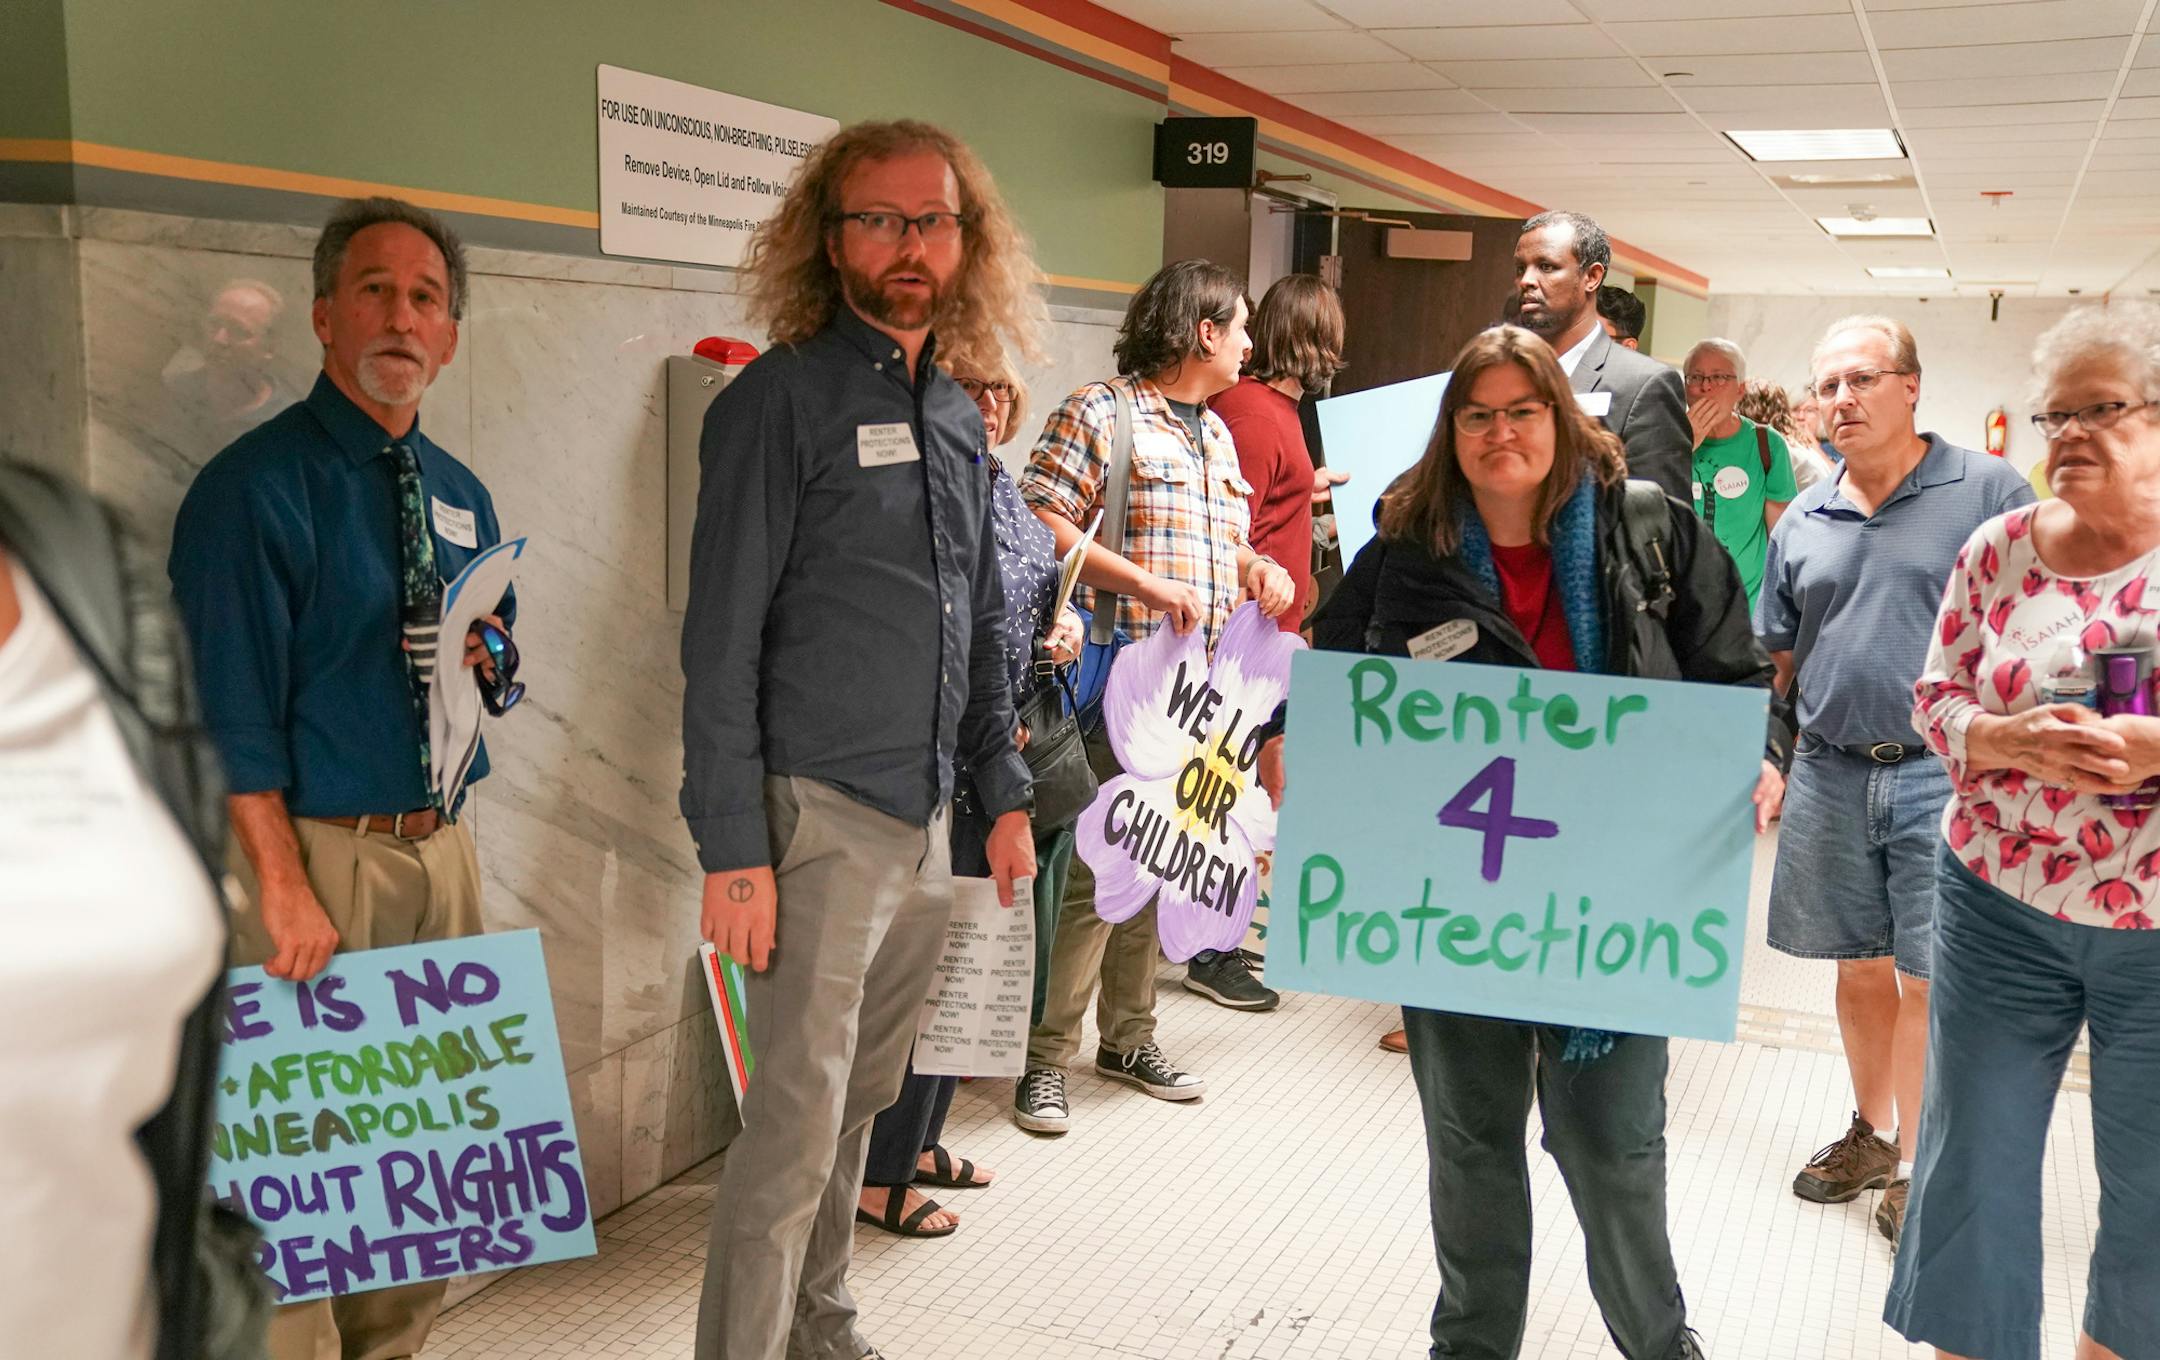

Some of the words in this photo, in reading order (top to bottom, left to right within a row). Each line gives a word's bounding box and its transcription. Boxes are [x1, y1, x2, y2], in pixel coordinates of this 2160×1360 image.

[602, 98, 620, 121] FOR
[621, 103, 639, 125] USE
[640, 107, 653, 128] ON
[654, 110, 713, 143] UNCONSCIOUS,
[714, 123, 774, 155] NON-BREATHING,
[1187, 142, 1229, 165] 319
[624, 154, 660, 177] Remove
[662, 161, 691, 185] Device,
[694, 166, 716, 188] Open
[717, 170, 730, 189] Lid
[731, 175, 745, 191] and
[747, 176, 771, 195] Follow
[772, 180, 791, 199] Voic
[621, 201, 658, 219] Maintained
[660, 207, 688, 226] Courtesy
[689, 212, 696, 224] of
[697, 212, 707, 226] the
[708, 214, 743, 232] Minneapolis
[744, 219, 756, 232] Fire
[1414, 625, 1473, 659] PROTECTIONS
[1424, 620, 1458, 642] RENTER
[2020, 611, 2081, 651] ISAIAH
[1347, 657, 1649, 750] Renter
[1167, 660, 1223, 744] WE
[1217, 708, 1262, 788] LO
[1175, 757, 1238, 845] OUR
[1436, 755, 1560, 883] 4
[1103, 789, 1249, 917] CHILDREN
[949, 920, 978, 931] RENTER
[1298, 852, 1731, 989] Protections
[944, 954, 974, 965] RENTER
[296, 975, 367, 1033] IS
[385, 958, 500, 1028] NO
[925, 998, 977, 1011] PROTECTIONS
[938, 989, 969, 1000] RENTER
[984, 1003, 1028, 1013] PROTECTIONS
[996, 993, 1022, 1002] RENTER
[920, 1033, 971, 1046] PROTECTIONS
[933, 1024, 963, 1035] RENTER
[978, 1039, 1022, 1049] PROTECTIONS
[990, 1029, 1016, 1038] RENTER
[248, 1013, 535, 1110] AFFORDABLE
[377, 1121, 587, 1233] RIGHTS
[254, 1219, 536, 1302] RENTERS
